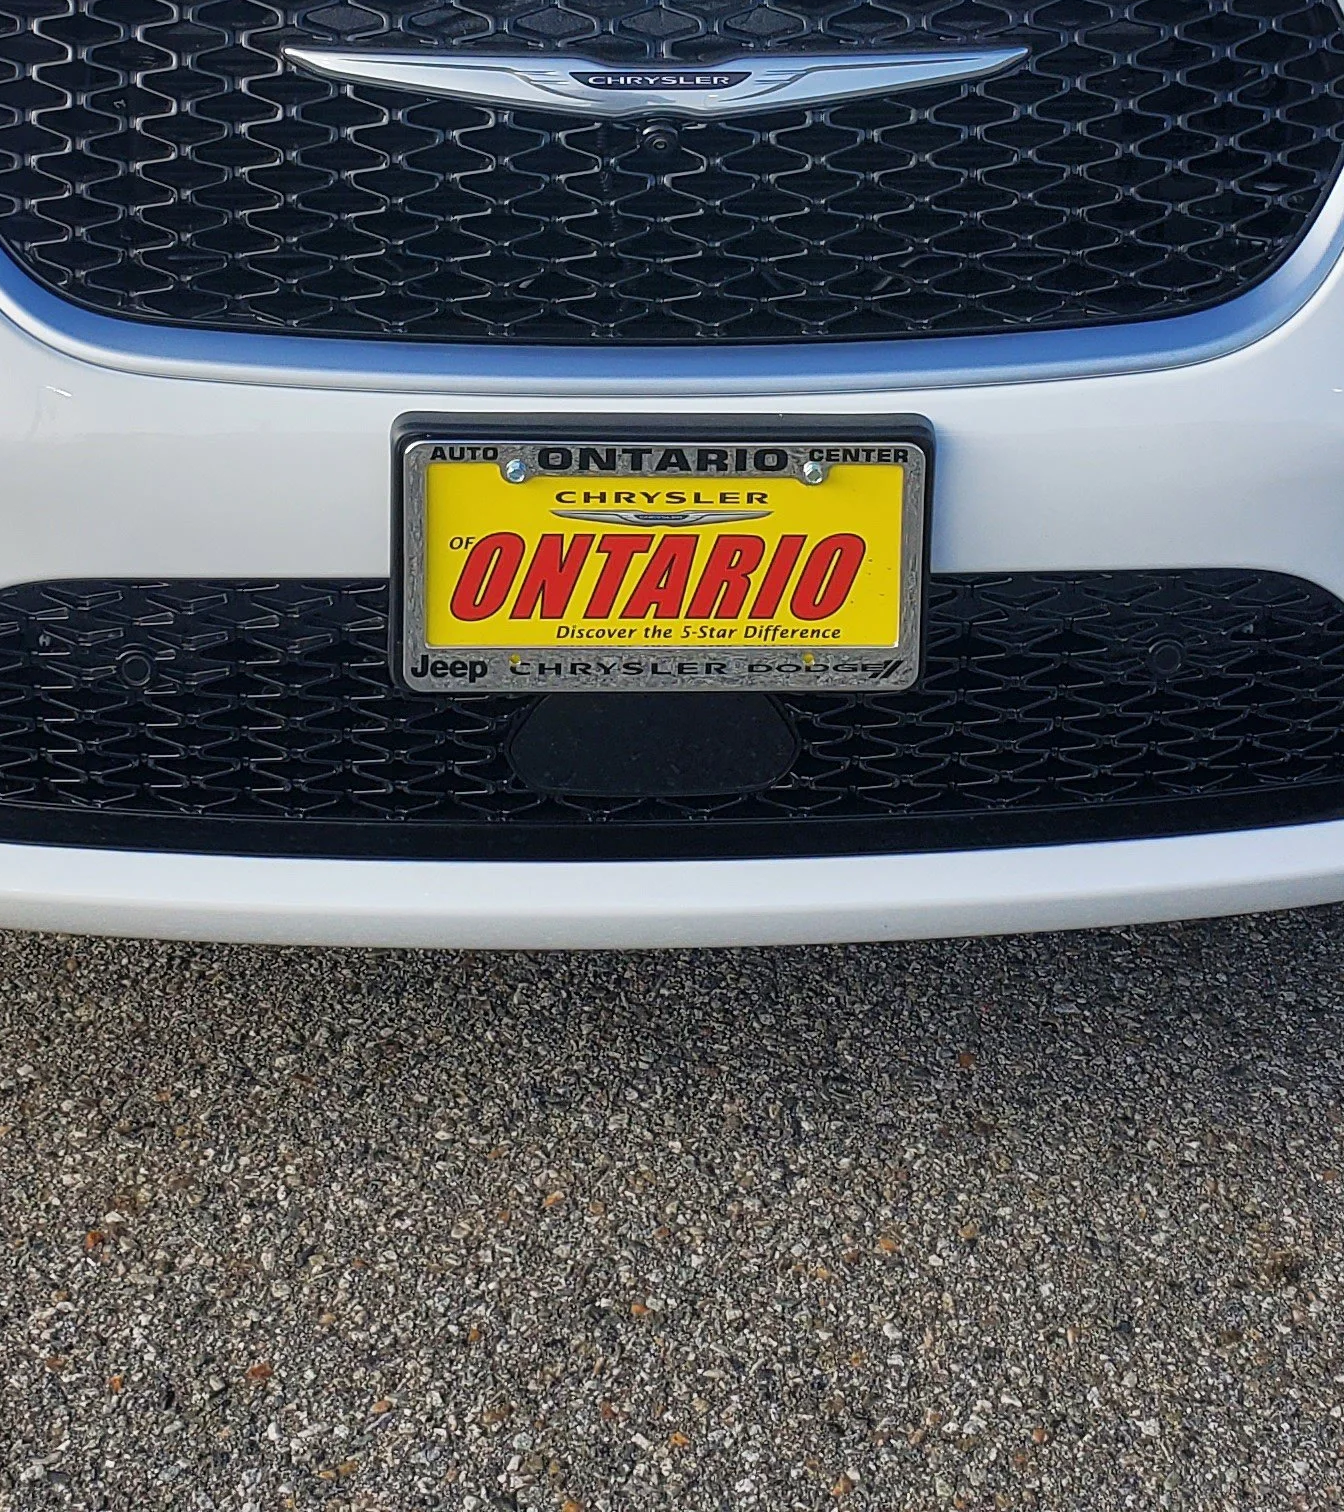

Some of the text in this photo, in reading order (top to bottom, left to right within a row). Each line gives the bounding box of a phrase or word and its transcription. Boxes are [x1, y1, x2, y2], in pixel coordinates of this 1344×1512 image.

[588, 76, 730, 85] CHRYSLER
[430, 446, 909, 472] AUTO ONTARIO CENTER
[555, 491, 769, 504] CHRYSLER
[449, 531, 867, 622] OF ONTARIO
[556, 624, 841, 641] Discover the 5-Star Difference
[410, 654, 886, 683] Jeep CHRYSLER DODGE
